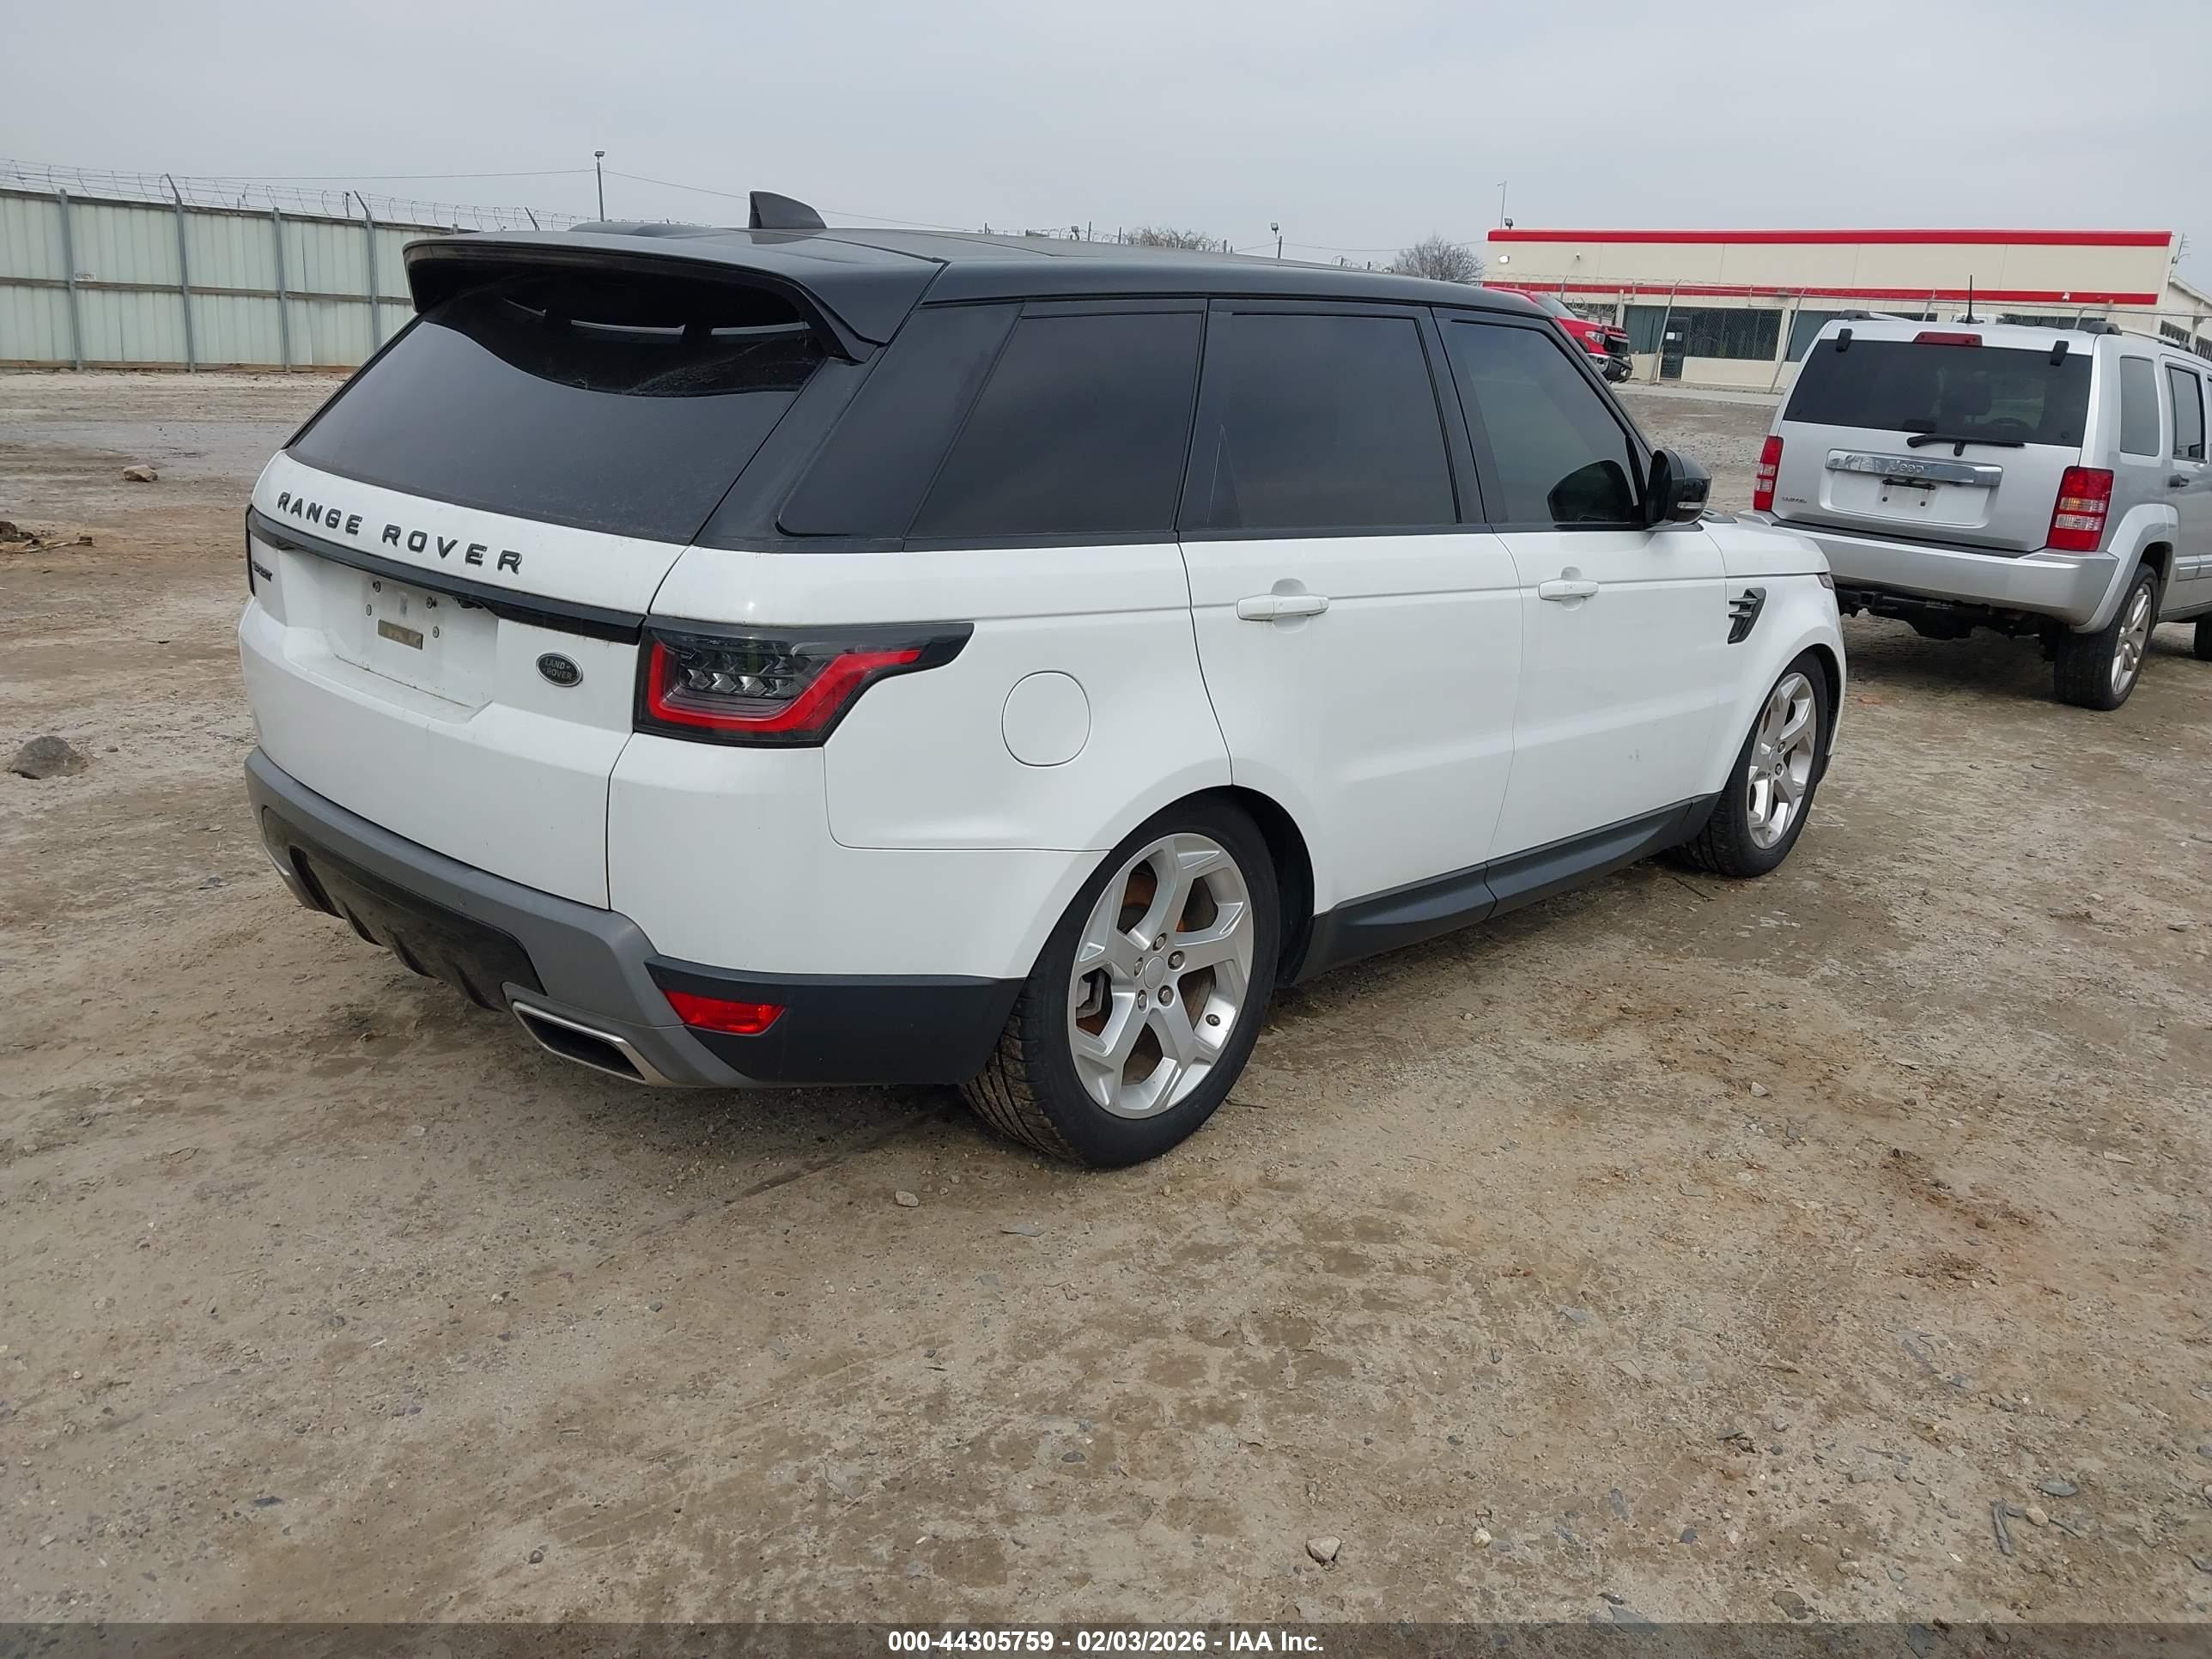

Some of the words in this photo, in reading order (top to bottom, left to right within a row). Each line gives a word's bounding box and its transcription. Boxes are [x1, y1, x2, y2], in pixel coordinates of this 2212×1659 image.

[1890, 460, 1924, 474] Jeep
[277, 491, 363, 536] RANGE
[382, 524, 522, 574] ROVER
